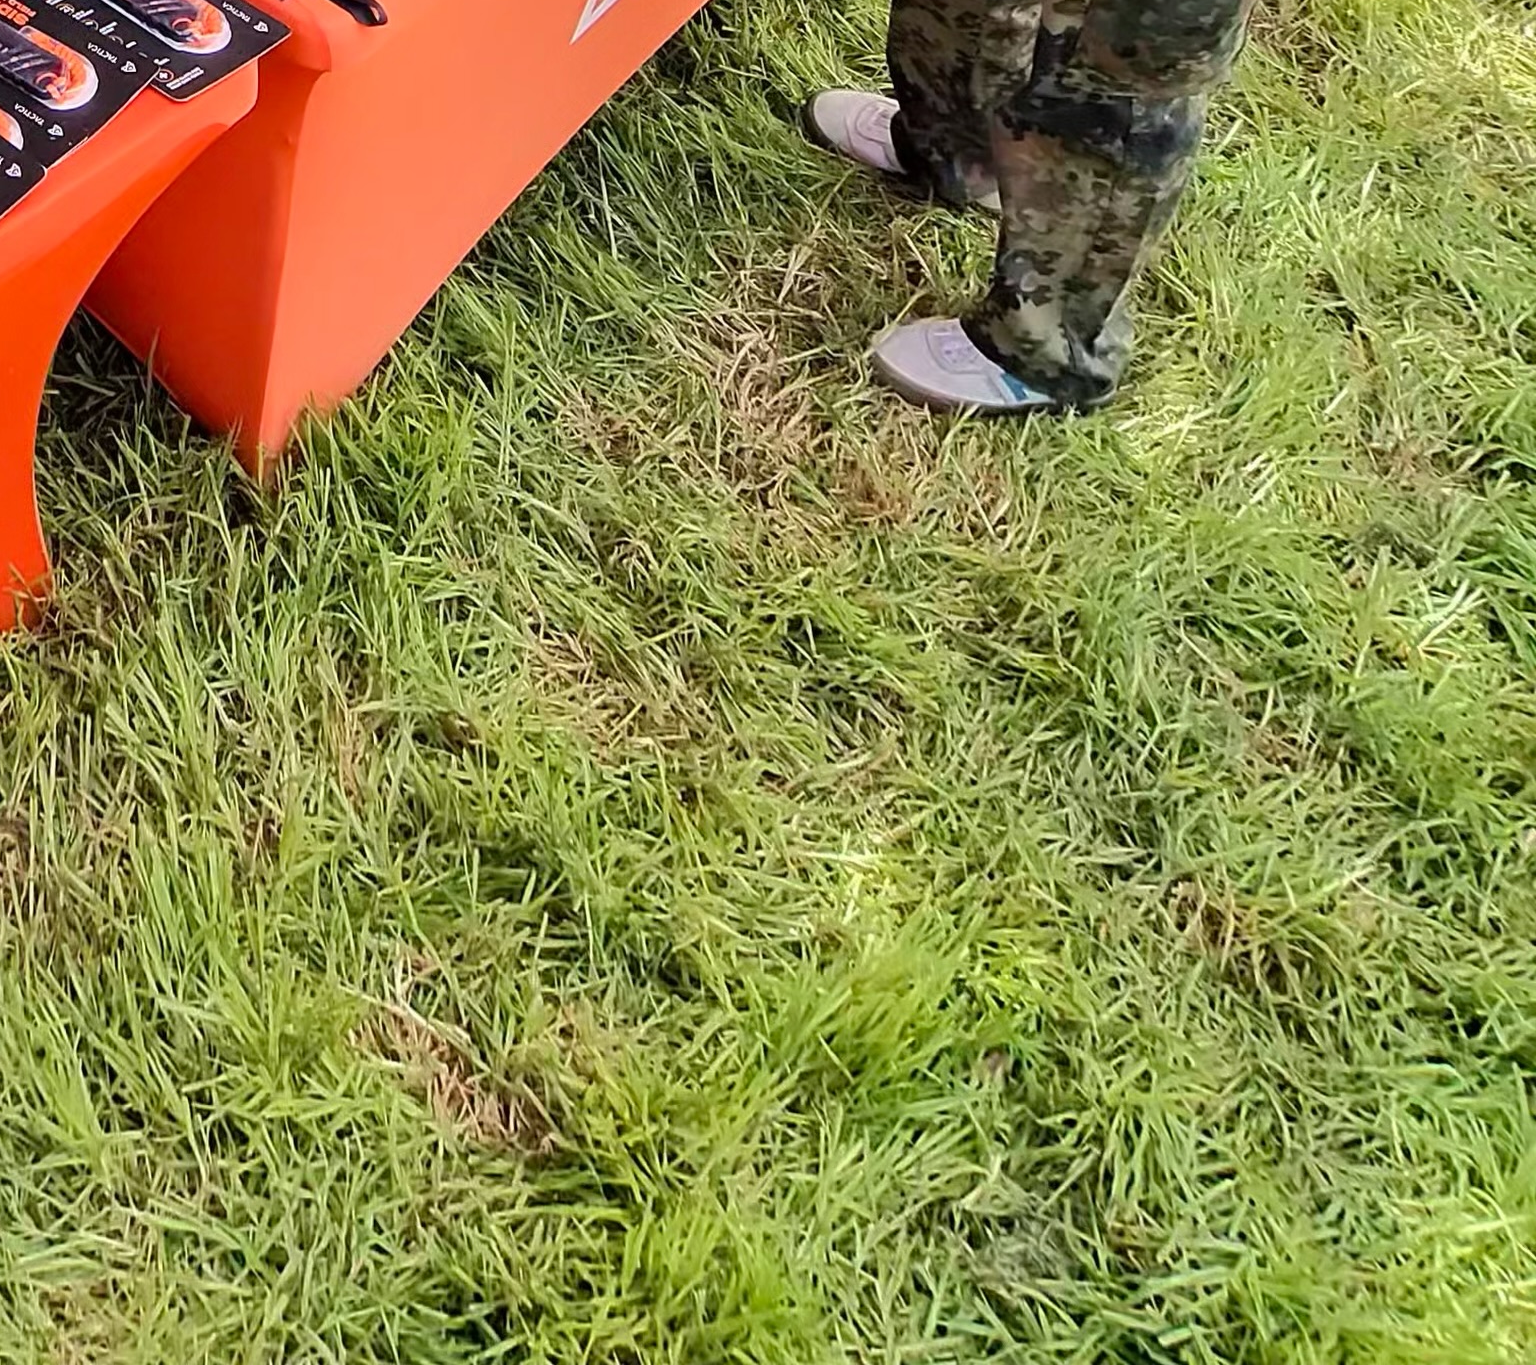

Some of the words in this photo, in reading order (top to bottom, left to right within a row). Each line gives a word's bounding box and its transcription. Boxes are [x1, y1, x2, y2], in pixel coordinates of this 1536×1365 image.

[221, 0, 252, 23] TACTICA
[86, 42, 118, 65] TACTICA
[14, 102, 46, 127] TACTICA
